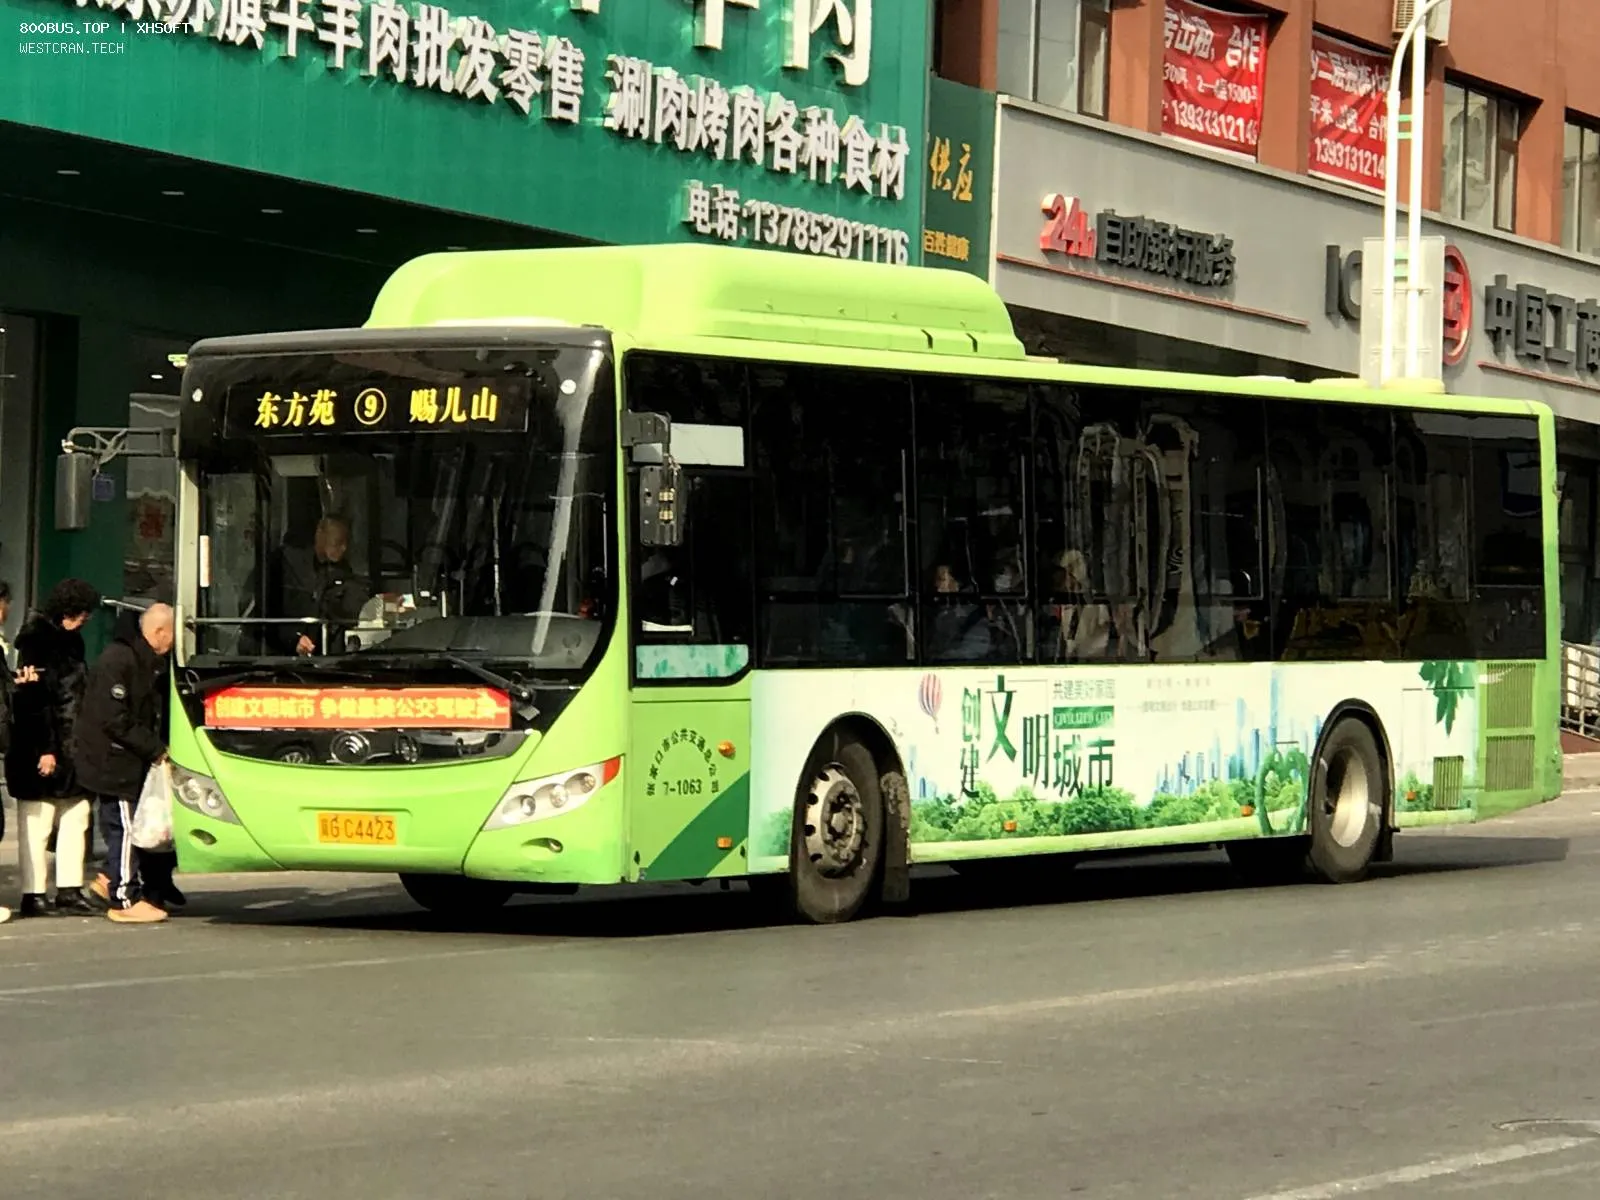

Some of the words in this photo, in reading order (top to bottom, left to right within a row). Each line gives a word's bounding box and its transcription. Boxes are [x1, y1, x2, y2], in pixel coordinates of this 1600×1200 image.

[606, 53, 909, 200] 涮肉烤肉各种食材
[1097, 207, 1237, 287] 自助银行服务
[253, 389, 338, 429] 东方苑
[662, 778, 703, 797] 7-1063
